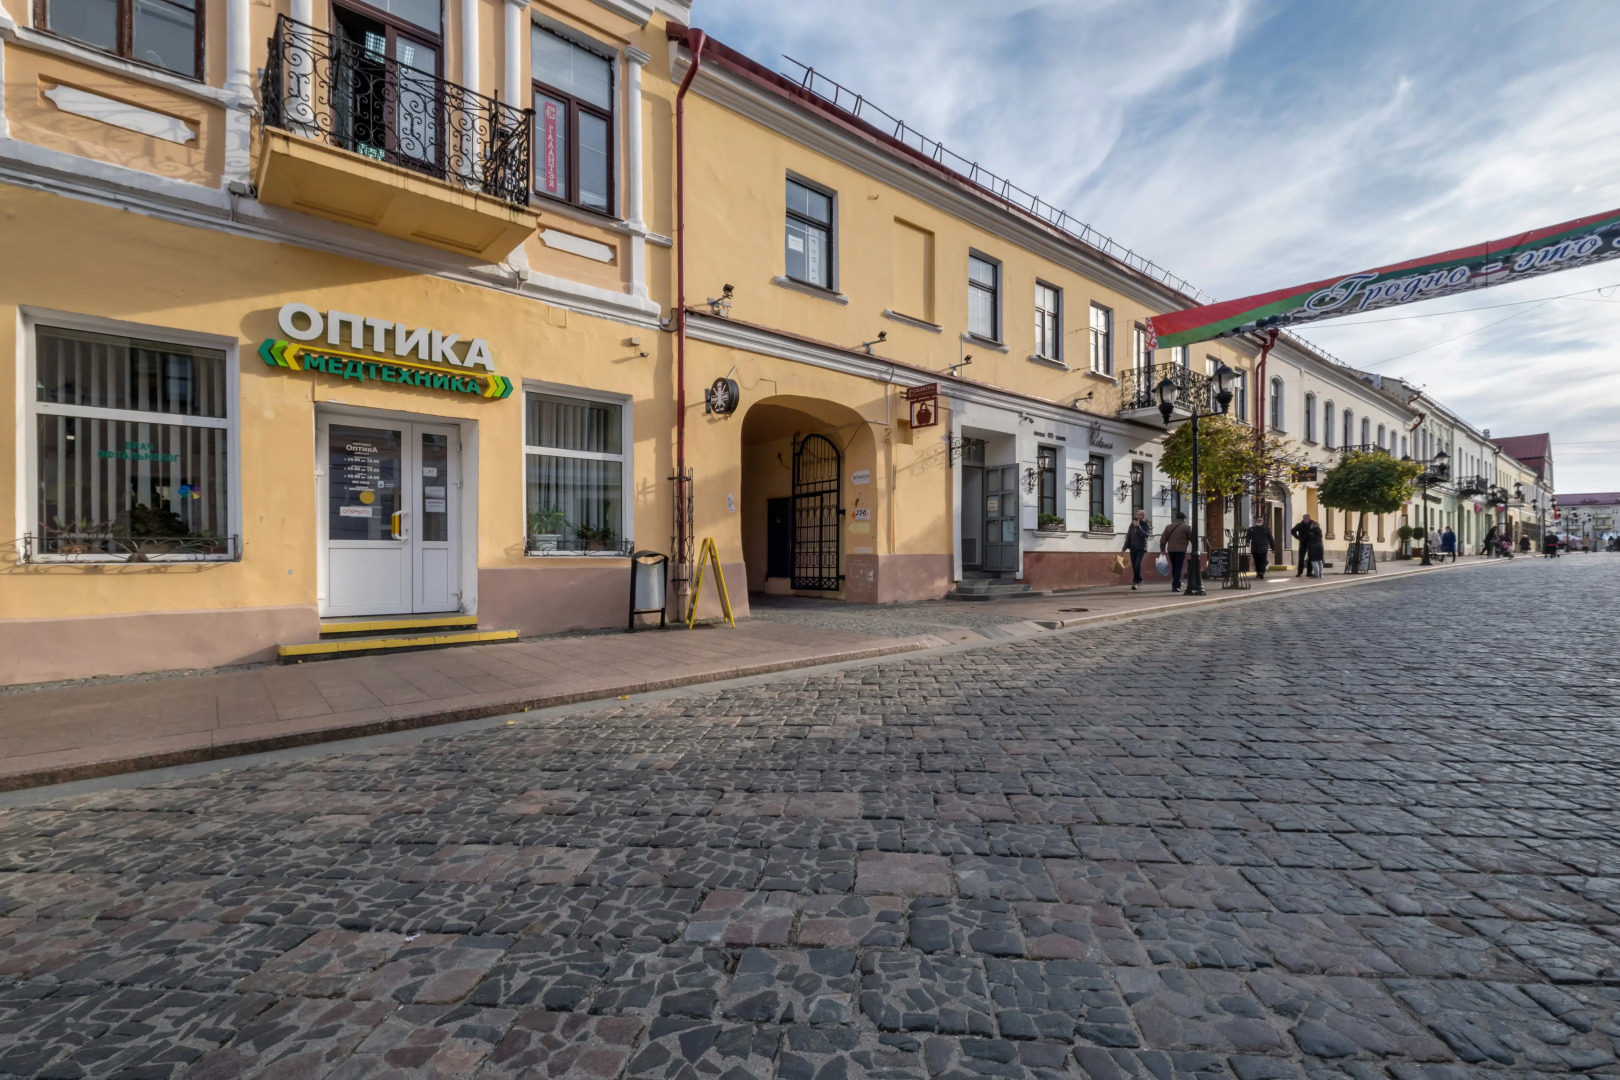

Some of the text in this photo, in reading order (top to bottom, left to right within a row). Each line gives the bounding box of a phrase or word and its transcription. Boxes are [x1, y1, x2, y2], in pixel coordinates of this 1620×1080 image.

[1305, 272, 1471, 312] Гродно
[1514, 235, 1604, 272] это
[278, 302, 495, 372] ОПТИКА
[303, 353, 482, 395] МЕДТЕХНИКА
[97, 450, 180, 462] ОФТАЛЬМОЛОГ
[124, 441, 154, 451] ВРАЧ
